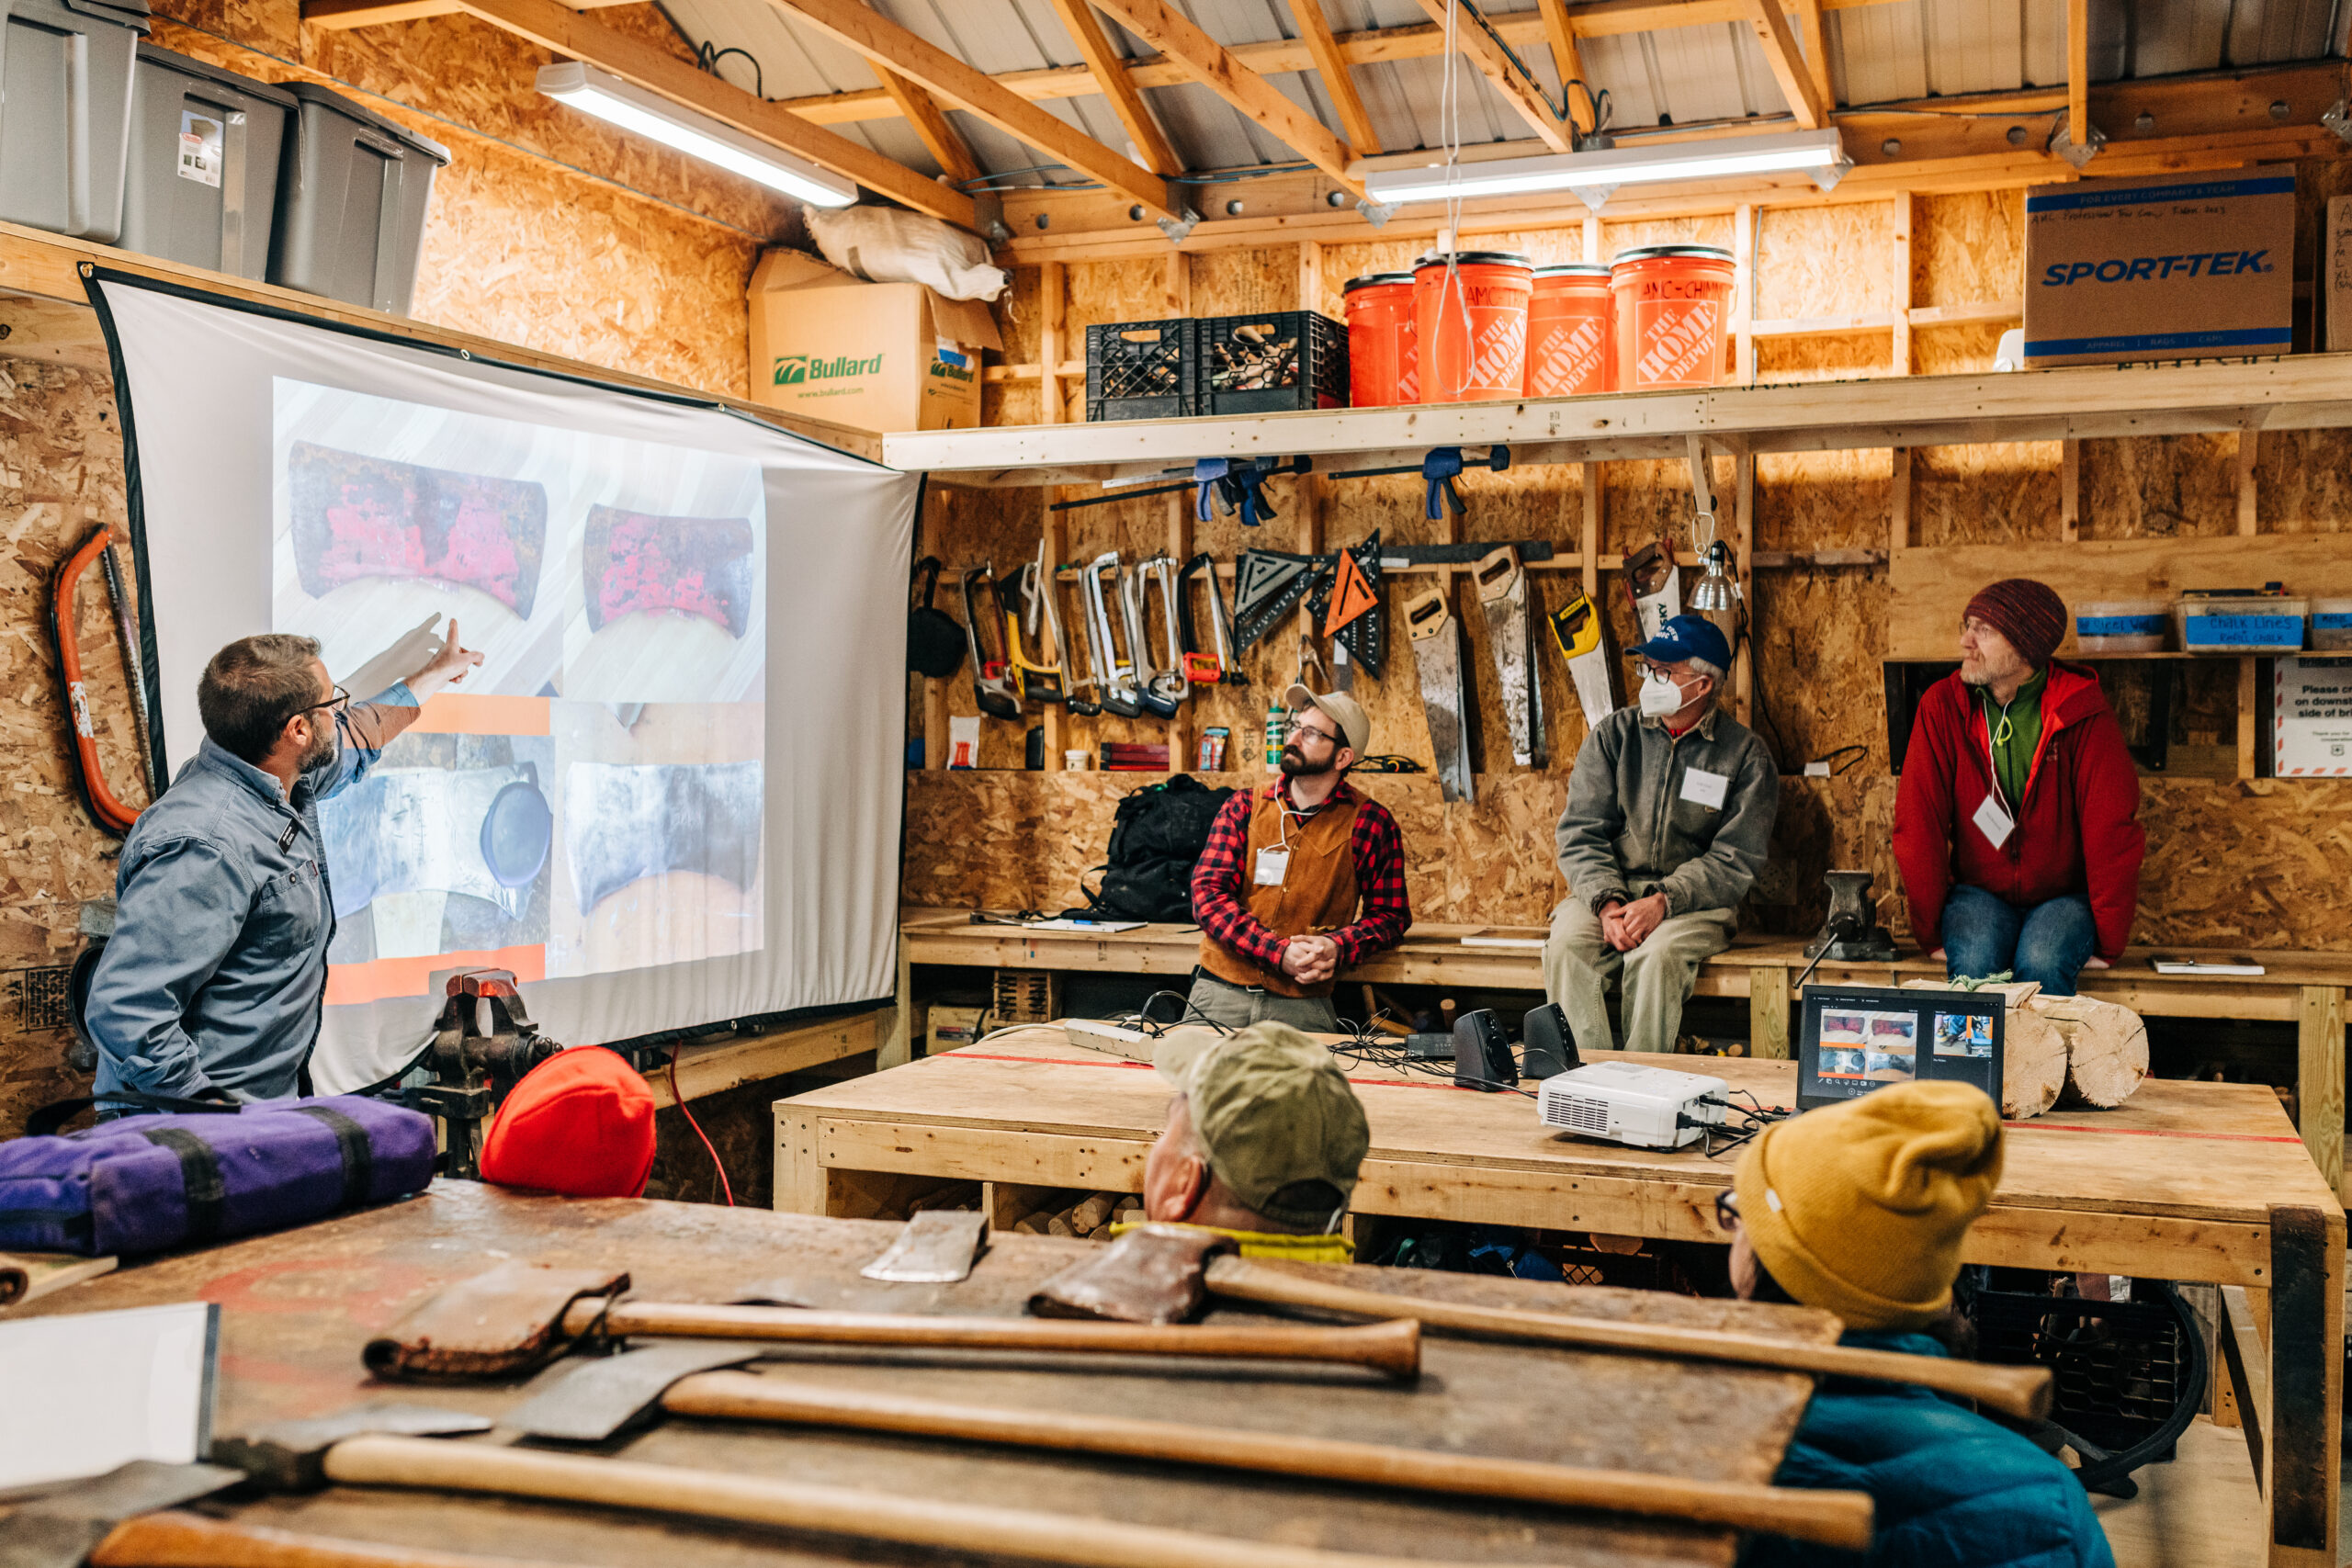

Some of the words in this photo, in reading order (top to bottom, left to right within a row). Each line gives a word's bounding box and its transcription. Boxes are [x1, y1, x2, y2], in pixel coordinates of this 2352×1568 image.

[2041, 250, 2269, 288] SPORT-TEK
[1477, 315, 1509, 347] THE
[1536, 325, 1568, 358] THE
[1637, 300, 1716, 382] HOME
[1645, 308, 1681, 343] THE
[809, 354, 883, 379] Bullard
[1532, 316, 1604, 397] HOME
[1558, 346, 1604, 396] DEPOT
[1668, 332, 1715, 381] DEPOT
[797, 387, 864, 400] www.bullard.com
[1657, 603, 1668, 626] SKY
[2294, 698, 2309, 706] on
[2301, 684, 2339, 694] Please
[2299, 708, 2322, 717] side
[2324, 708, 2335, 717] of
[2338, 707, 2352, 717] bri
